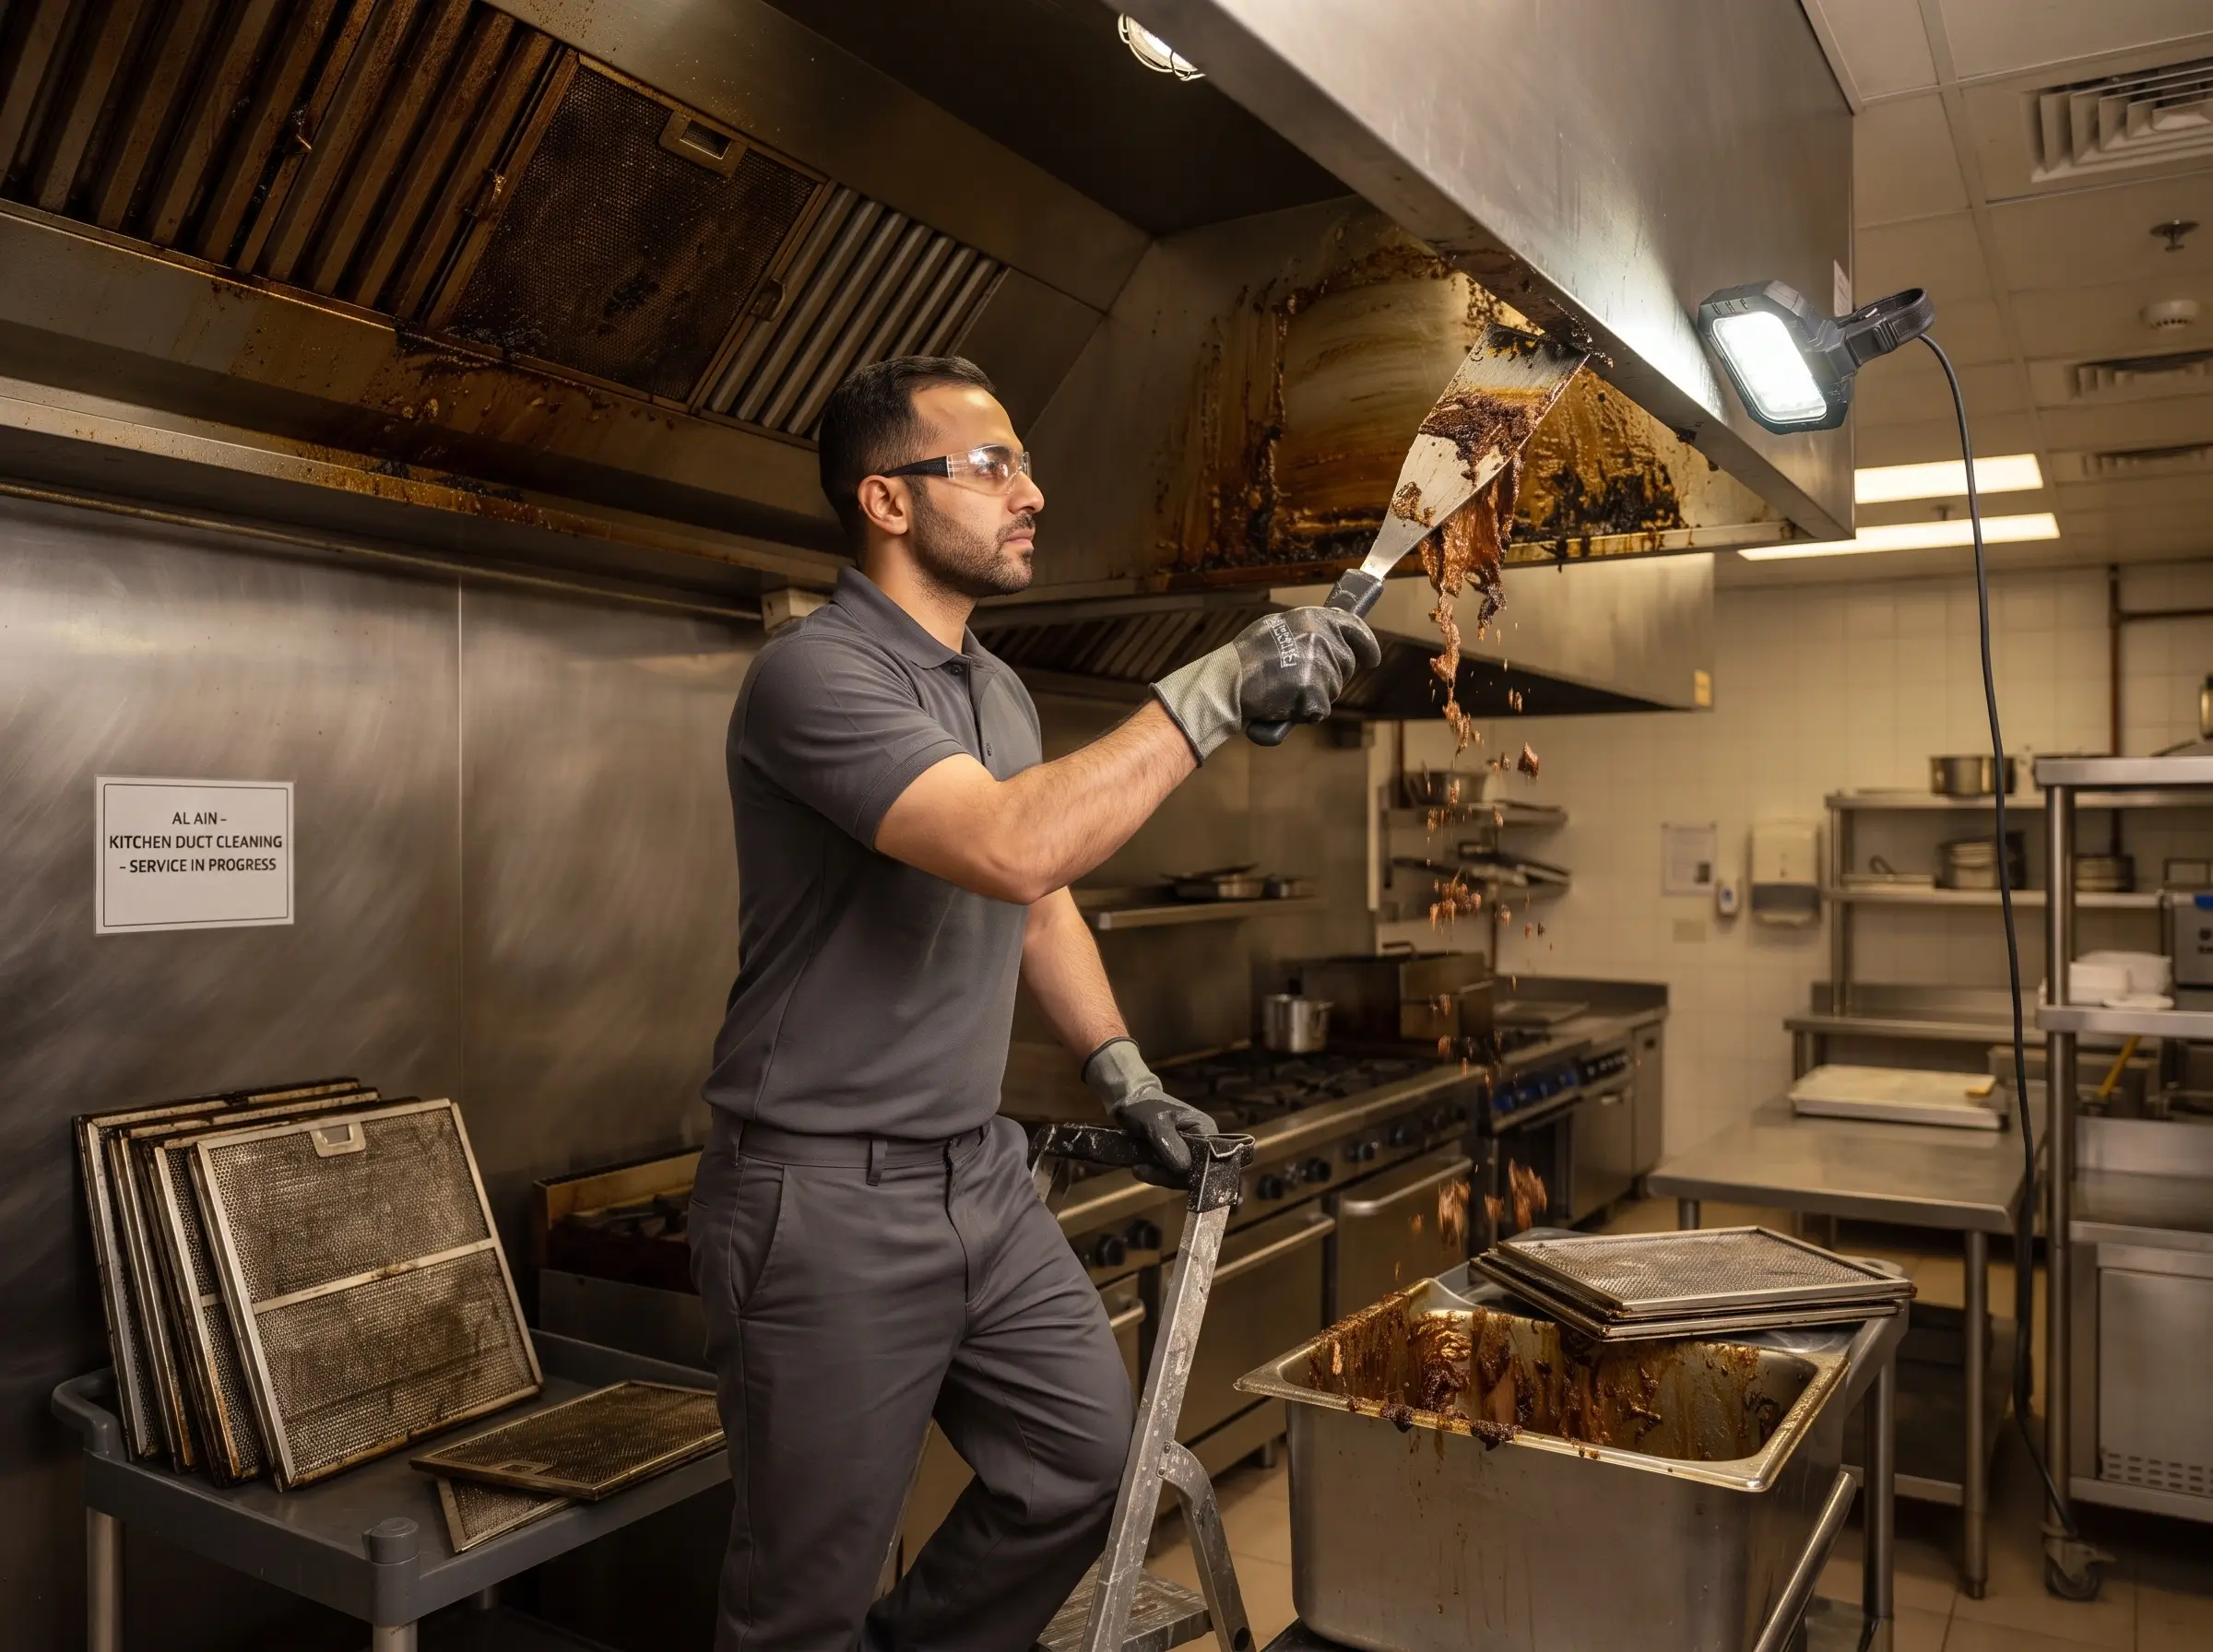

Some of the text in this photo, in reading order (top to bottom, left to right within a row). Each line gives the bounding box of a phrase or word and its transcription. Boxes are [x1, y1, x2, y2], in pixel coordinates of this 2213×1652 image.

[172, 811, 191, 825] AL
[193, 811, 218, 825] AIN
[109, 834, 283, 849] KITCHEN DUCT CLEANING
[129, 858, 187, 873] SERVICE
[190, 858, 206, 872] IN
[208, 857, 277, 871] PROGRESS
